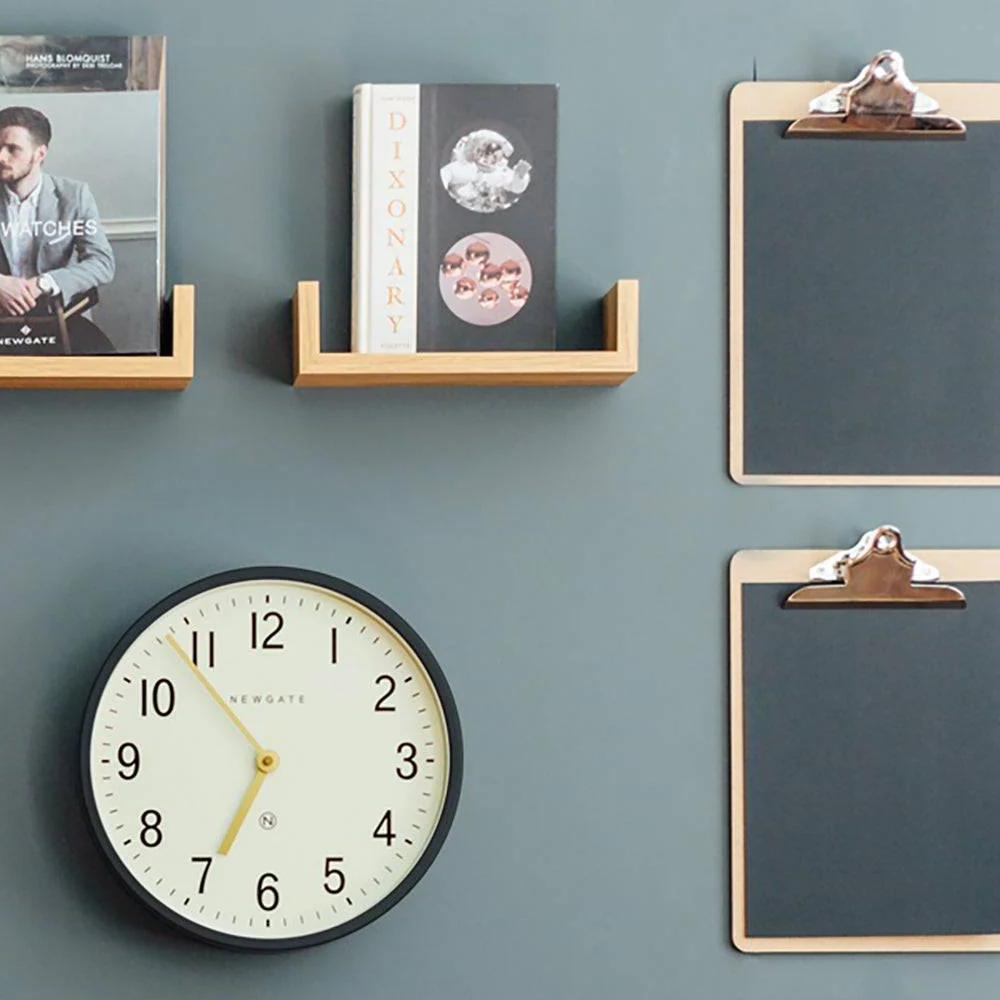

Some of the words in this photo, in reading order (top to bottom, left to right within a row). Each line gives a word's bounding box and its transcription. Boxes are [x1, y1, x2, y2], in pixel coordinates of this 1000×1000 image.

[26, 54, 53, 62] HANS
[56, 54, 110, 62] BLOMQUIST
[1, 219, 97, 237] WATCHES
[387, 111, 407, 334] DIXONARY
[252, 612, 284, 649] 12
[332, 628, 337, 664] 1
[193, 631, 214, 668] 11
[141, 679, 175, 717] 10
[230, 695, 305, 704] NEWGATE
[375, 675, 396, 711] 2
[118, 743, 140, 780] 9
[396, 742, 417, 780] 3
[140, 810, 162, 847] 8
[373, 810, 396, 846] 4
[192, 857, 212, 894] 7
[257, 873, 279, 911] 6
[324, 857, 345, 894] 5
